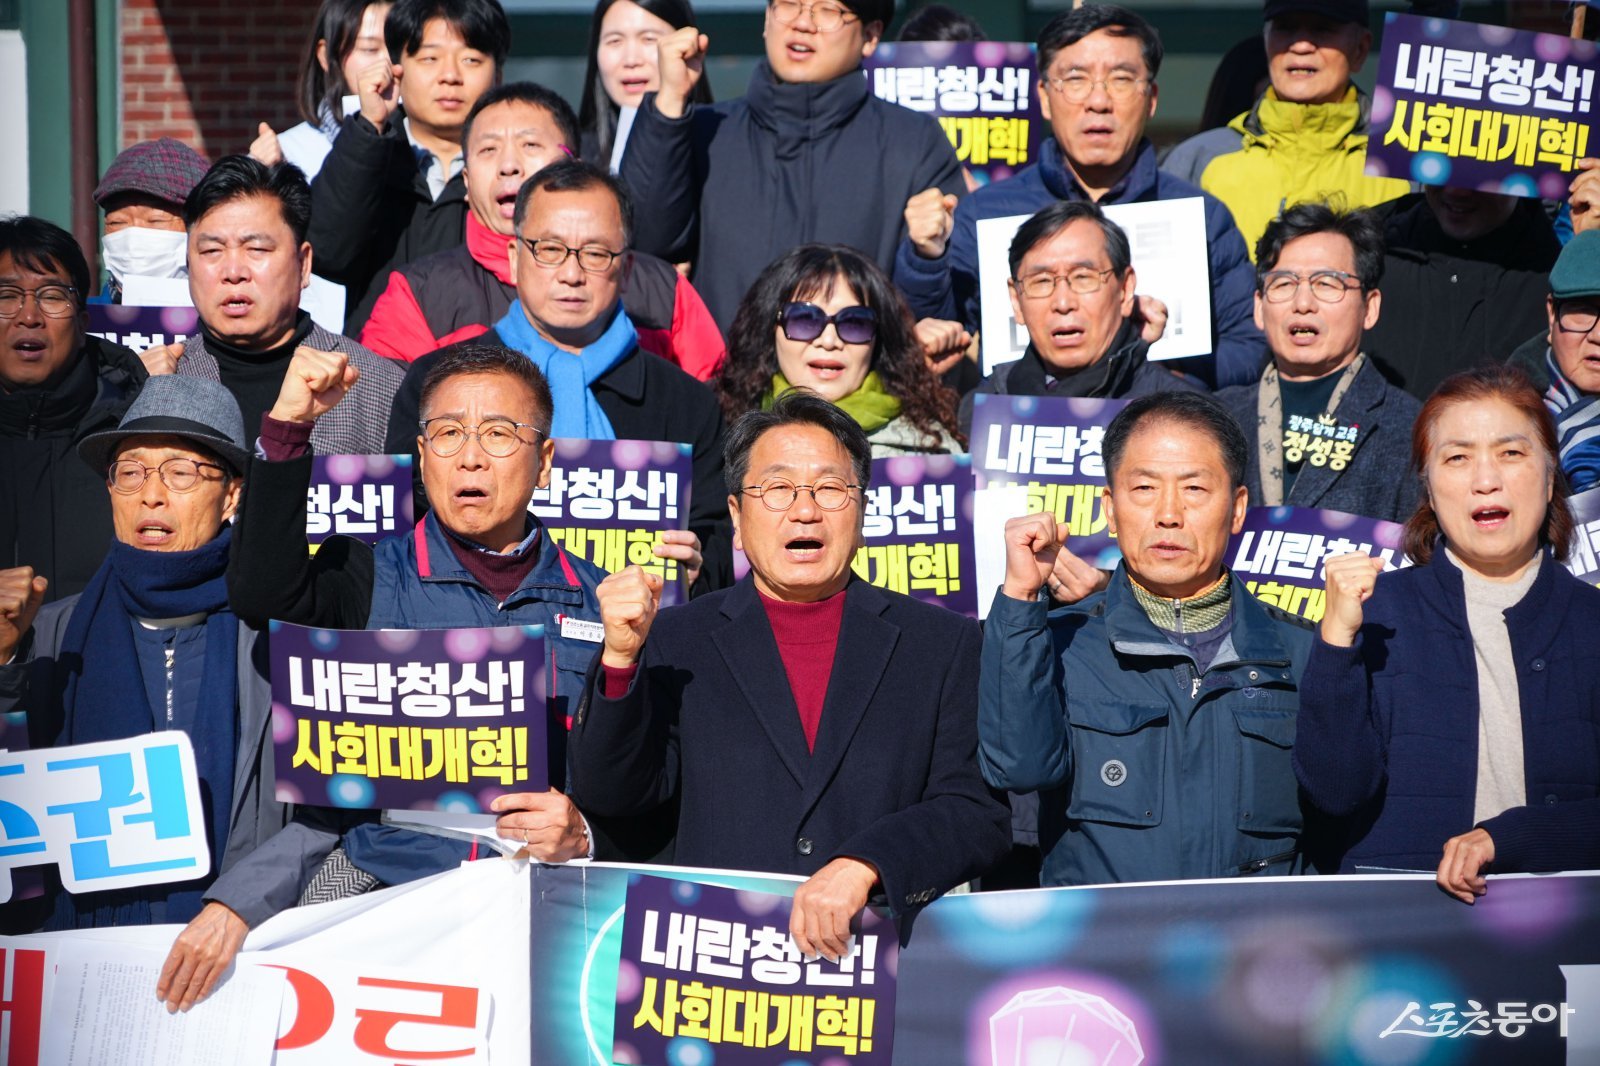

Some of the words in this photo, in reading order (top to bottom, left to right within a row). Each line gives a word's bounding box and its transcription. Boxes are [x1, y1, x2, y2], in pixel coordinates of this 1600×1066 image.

[1393, 42, 1595, 113] 내란청산!
[1383, 99, 1590, 172] 사회대개혁!
[1282, 430, 1355, 471] 정성홍
[289, 656, 525, 717] 내란청산!
[292, 719, 528, 785] 사회대개혁!
[633, 976, 876, 1056] 사회대개혁!
